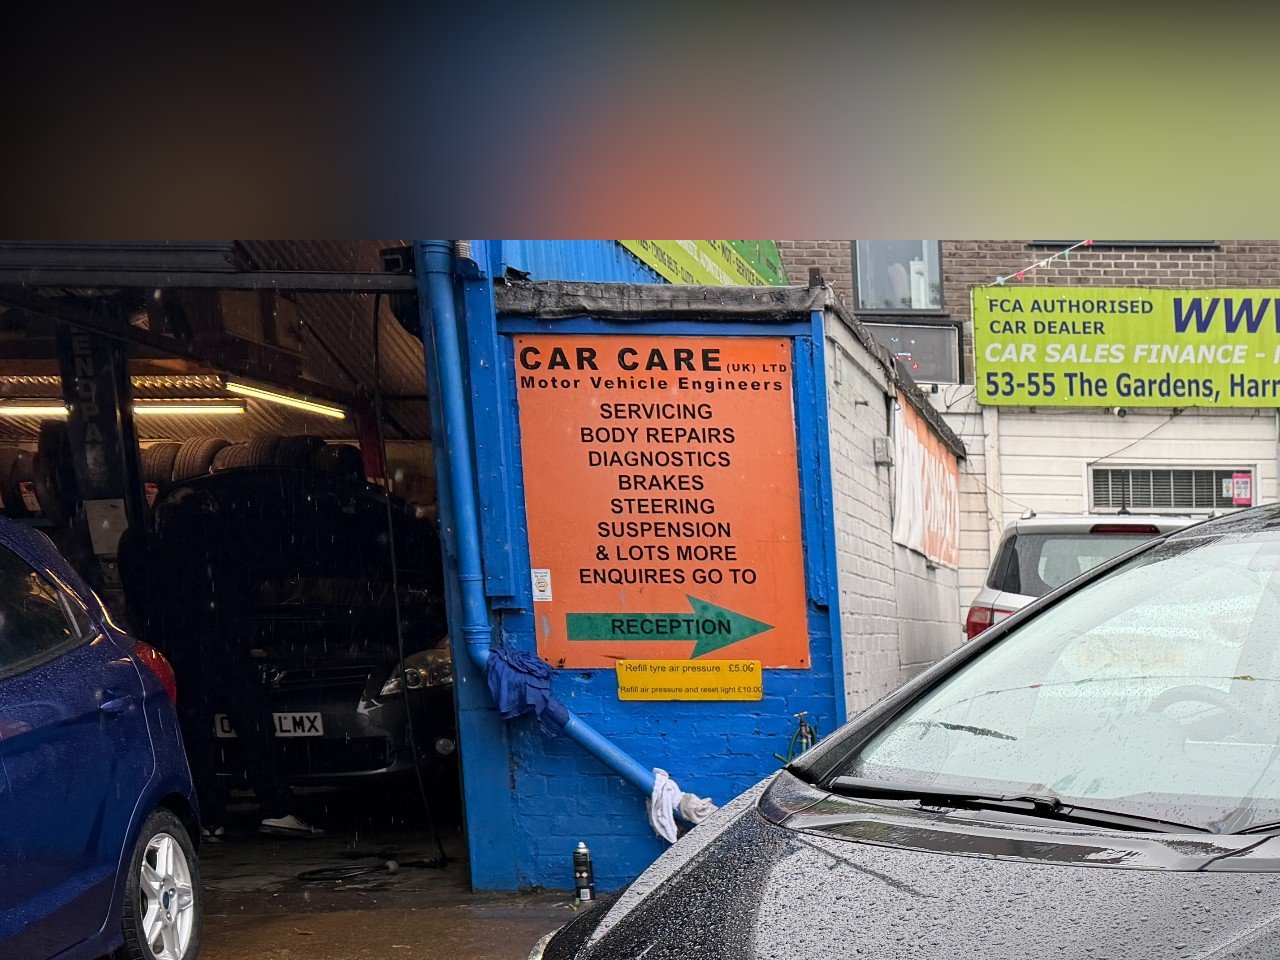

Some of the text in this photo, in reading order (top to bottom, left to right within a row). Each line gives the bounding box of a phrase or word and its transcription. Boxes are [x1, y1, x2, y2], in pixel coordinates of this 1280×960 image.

[988, 299, 1154, 315] FCA AUTHORISED
[988, 320, 1106, 335] CAR DEALER
[519, 346, 787, 374] CAR CARE (UK) LTD
[984, 343, 1039, 364] CAR
[1044, 343, 1126, 364] SALES
[1133, 344, 1248, 365] FINANCE
[520, 376, 783, 394] Motor Vehicle Engineers
[985, 372, 1055, 397] 53-55
[1064, 372, 1107, 398] The
[1115, 372, 1220, 403] Gardens,
[600, 403, 713, 420] SERVICING
[580, 427, 735, 444] BODY REPAIRS
[588, 451, 731, 467] DIAGNOSTICS
[618, 475, 704, 491] BRAKES
[610, 498, 715, 514] STEERING
[597, 522, 731, 538] SUSPENSION
[596, 545, 737, 561] & LOTS MORE
[579, 568, 757, 586] ENQUIRES GO TO
[611, 618, 732, 635] RECEPTION
[625, 664, 648, 673] Refill
[650, 664, 666, 674] tyre
[669, 664, 679, 673] air
[682, 666, 721, 674] pressure
[721, 686, 736, 694] light
[278, 716, 320, 733] LMX
